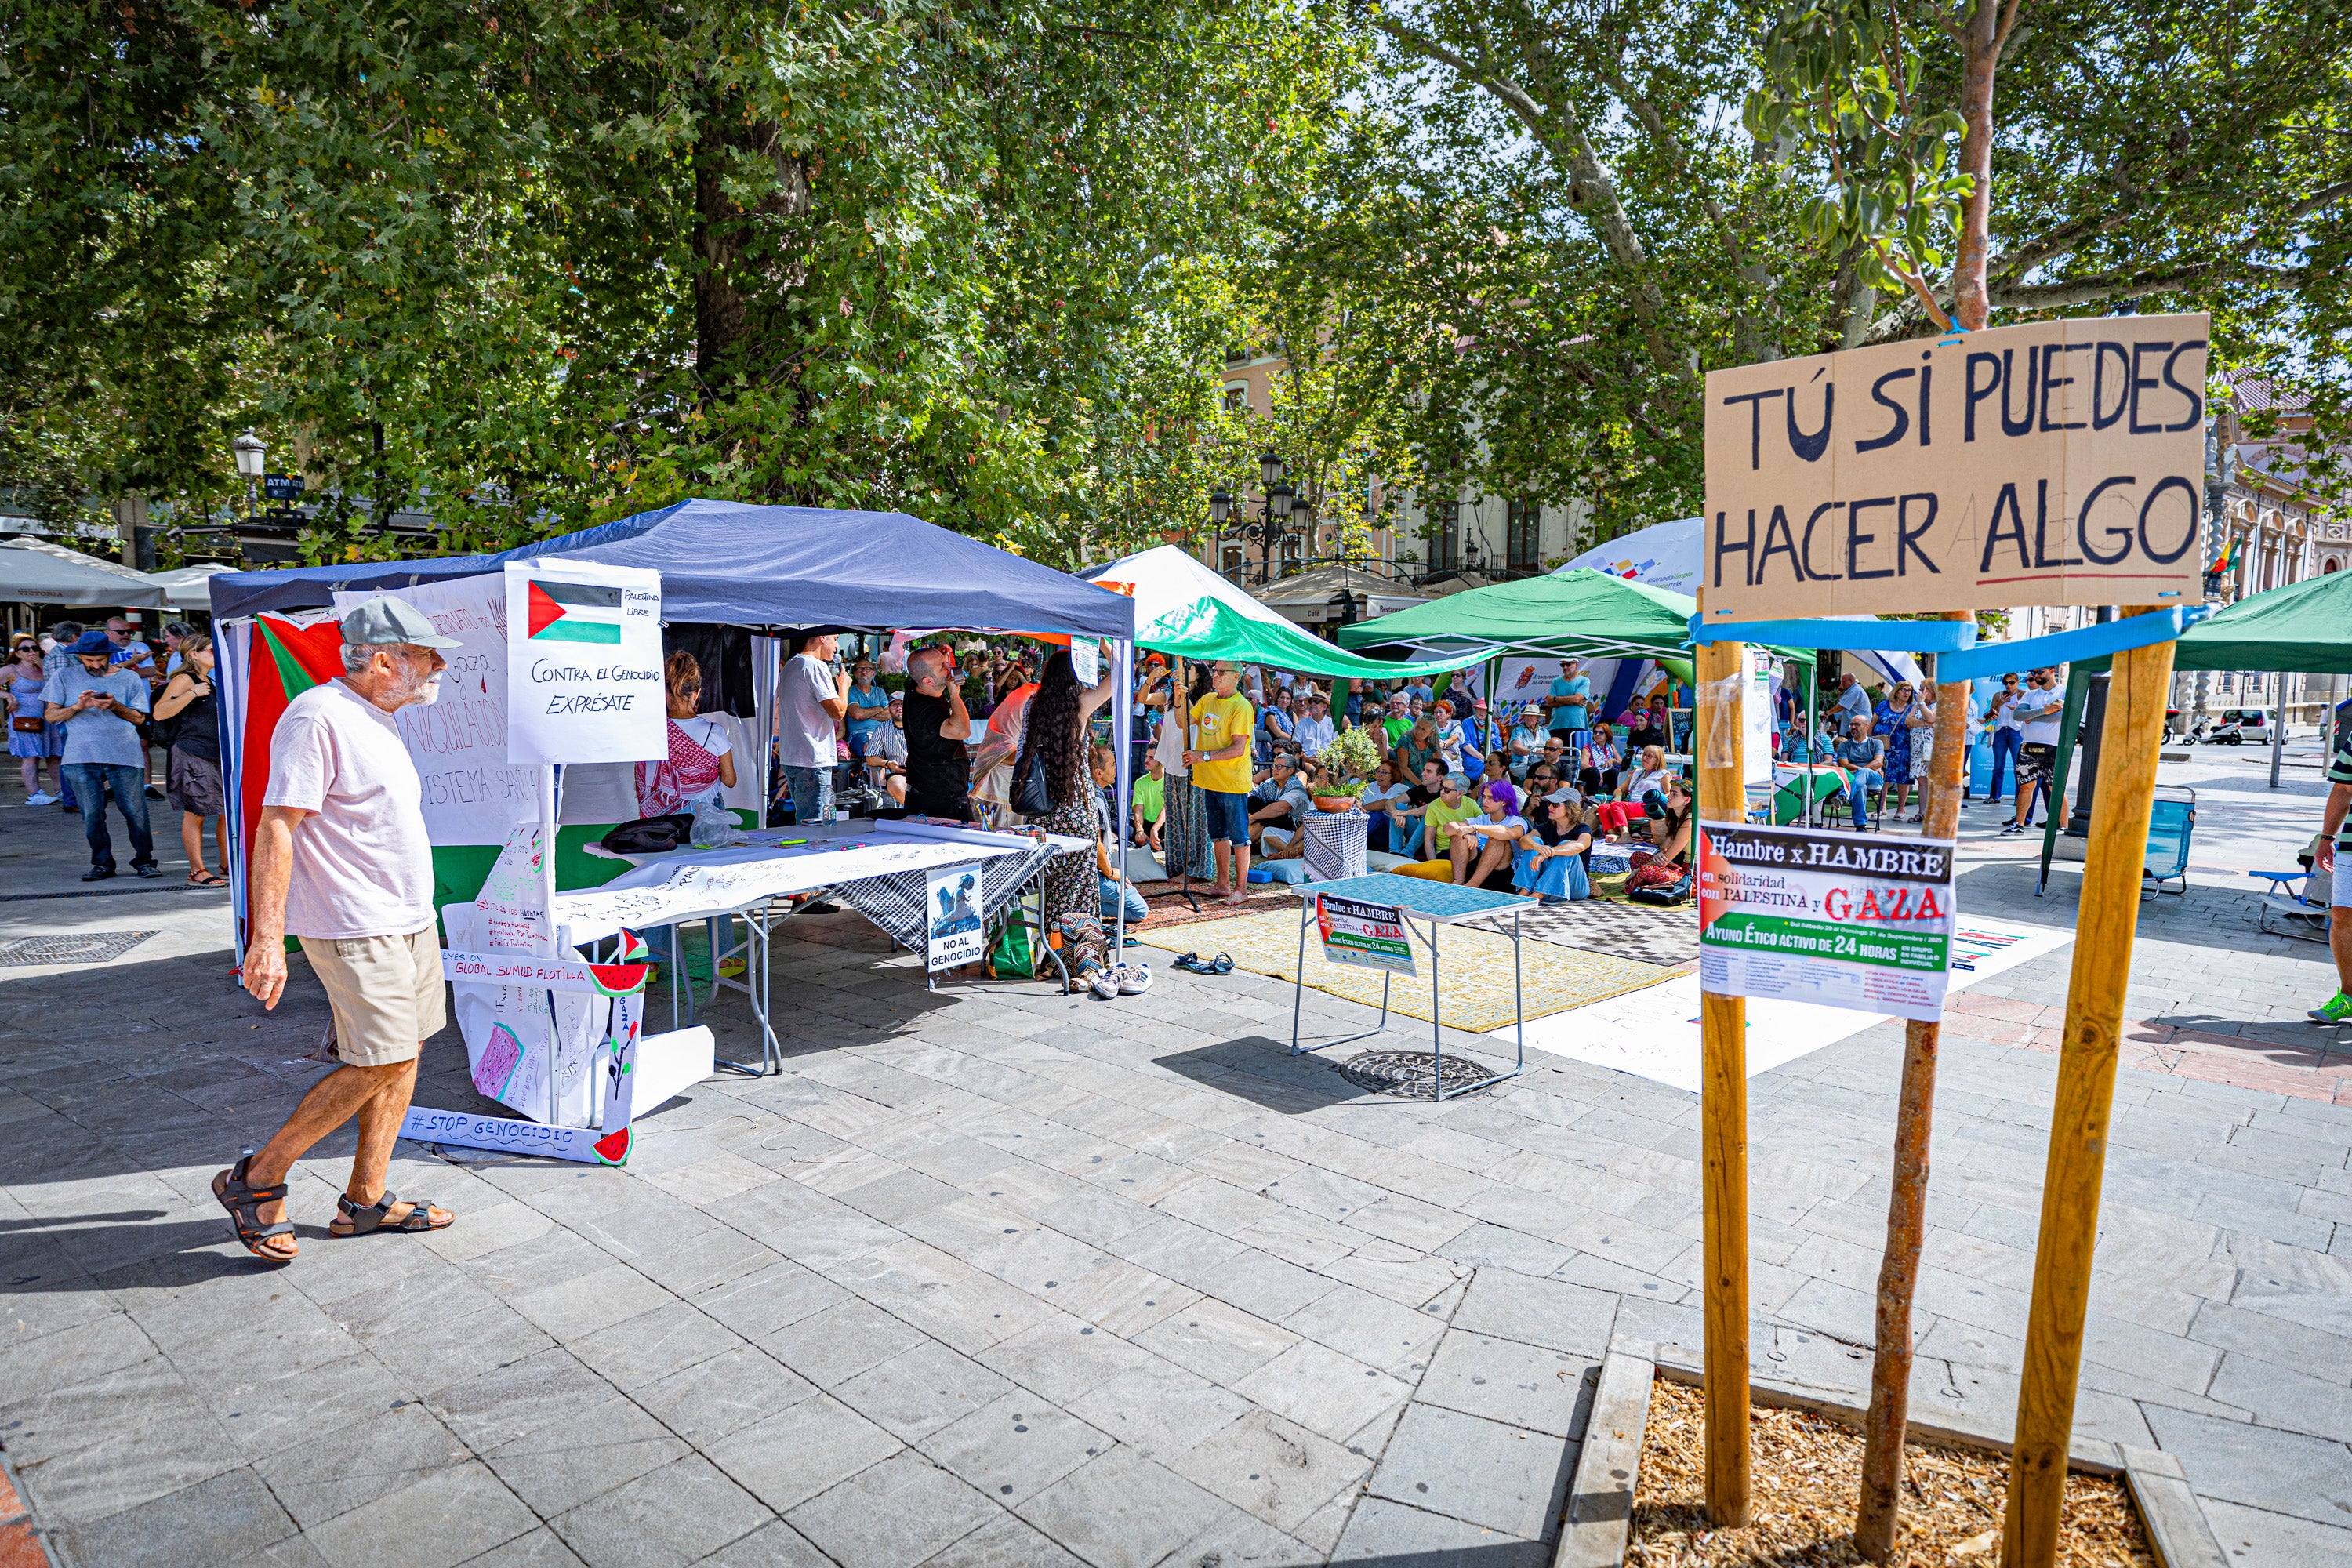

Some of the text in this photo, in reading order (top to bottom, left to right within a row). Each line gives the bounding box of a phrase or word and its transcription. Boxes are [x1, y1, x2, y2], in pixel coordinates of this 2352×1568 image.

[1723, 367, 1835, 470] TÚ
[1964, 339, 2208, 443] PUEDES
[292, 480, 304, 488] ATM
[1714, 475, 2199, 587] HACER ALGO
[624, 590, 660, 601] PALESTINA
[532, 658, 592, 684] CONTRA
[597, 667, 609, 680] EL
[546, 692, 635, 715] EXPRÉSATE
[420, 768, 493, 805] ISTEMA
[1709, 834, 1943, 877] Hambre x HAMBRE
[1701, 871, 1785, 889] en solidaridad
[1321, 898, 1345, 913] Hambre
[1352, 904, 1396, 922] HAMBRE
[1700, 887, 1720, 901] con
[1723, 887, 1809, 908] PALESTINA
[1813, 900, 1821, 913] y
[1824, 887, 1945, 921] GAZA
[1329, 922, 1359, 932] PALESTINA
[1362, 924, 1405, 937] GAZA
[1705, 920, 1897, 961] AYUNO ÉTICO ACTIVO DE 24 HORAS
[1840, 927, 1869, 937] Domingo
[1886, 932, 1924, 942] Septiembre
[943, 936, 970, 951] NO AL
[1371, 942, 1381, 950] 24
[442, 952, 484, 963] EYES ON
[931, 946, 981, 967] GENOCIDIO
[455, 962, 492, 975] GLOBAL
[495, 965, 533, 978] SUMUD
[619, 996, 630, 1031] GAZA
[411, 1113, 574, 1144] #STOP GENOCIDIO
